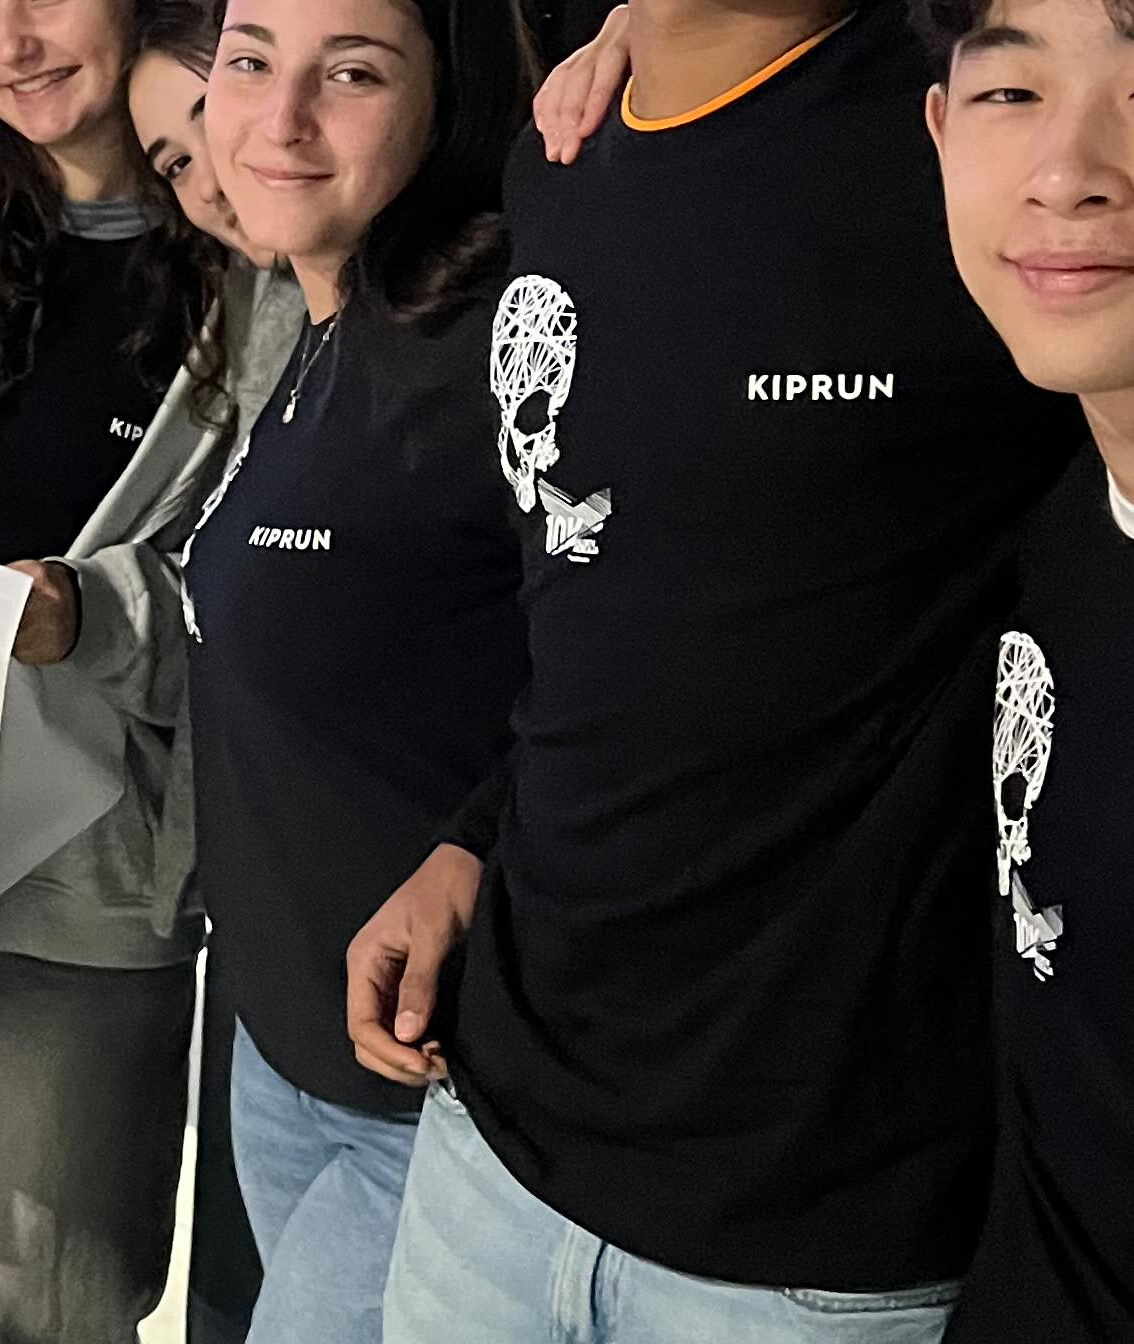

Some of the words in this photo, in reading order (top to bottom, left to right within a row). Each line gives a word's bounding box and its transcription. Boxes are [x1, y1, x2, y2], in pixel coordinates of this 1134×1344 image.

[746, 373, 894, 401] KIPRUN
[109, 417, 144, 441] KIP
[248, 525, 331, 550] KIPRUN
